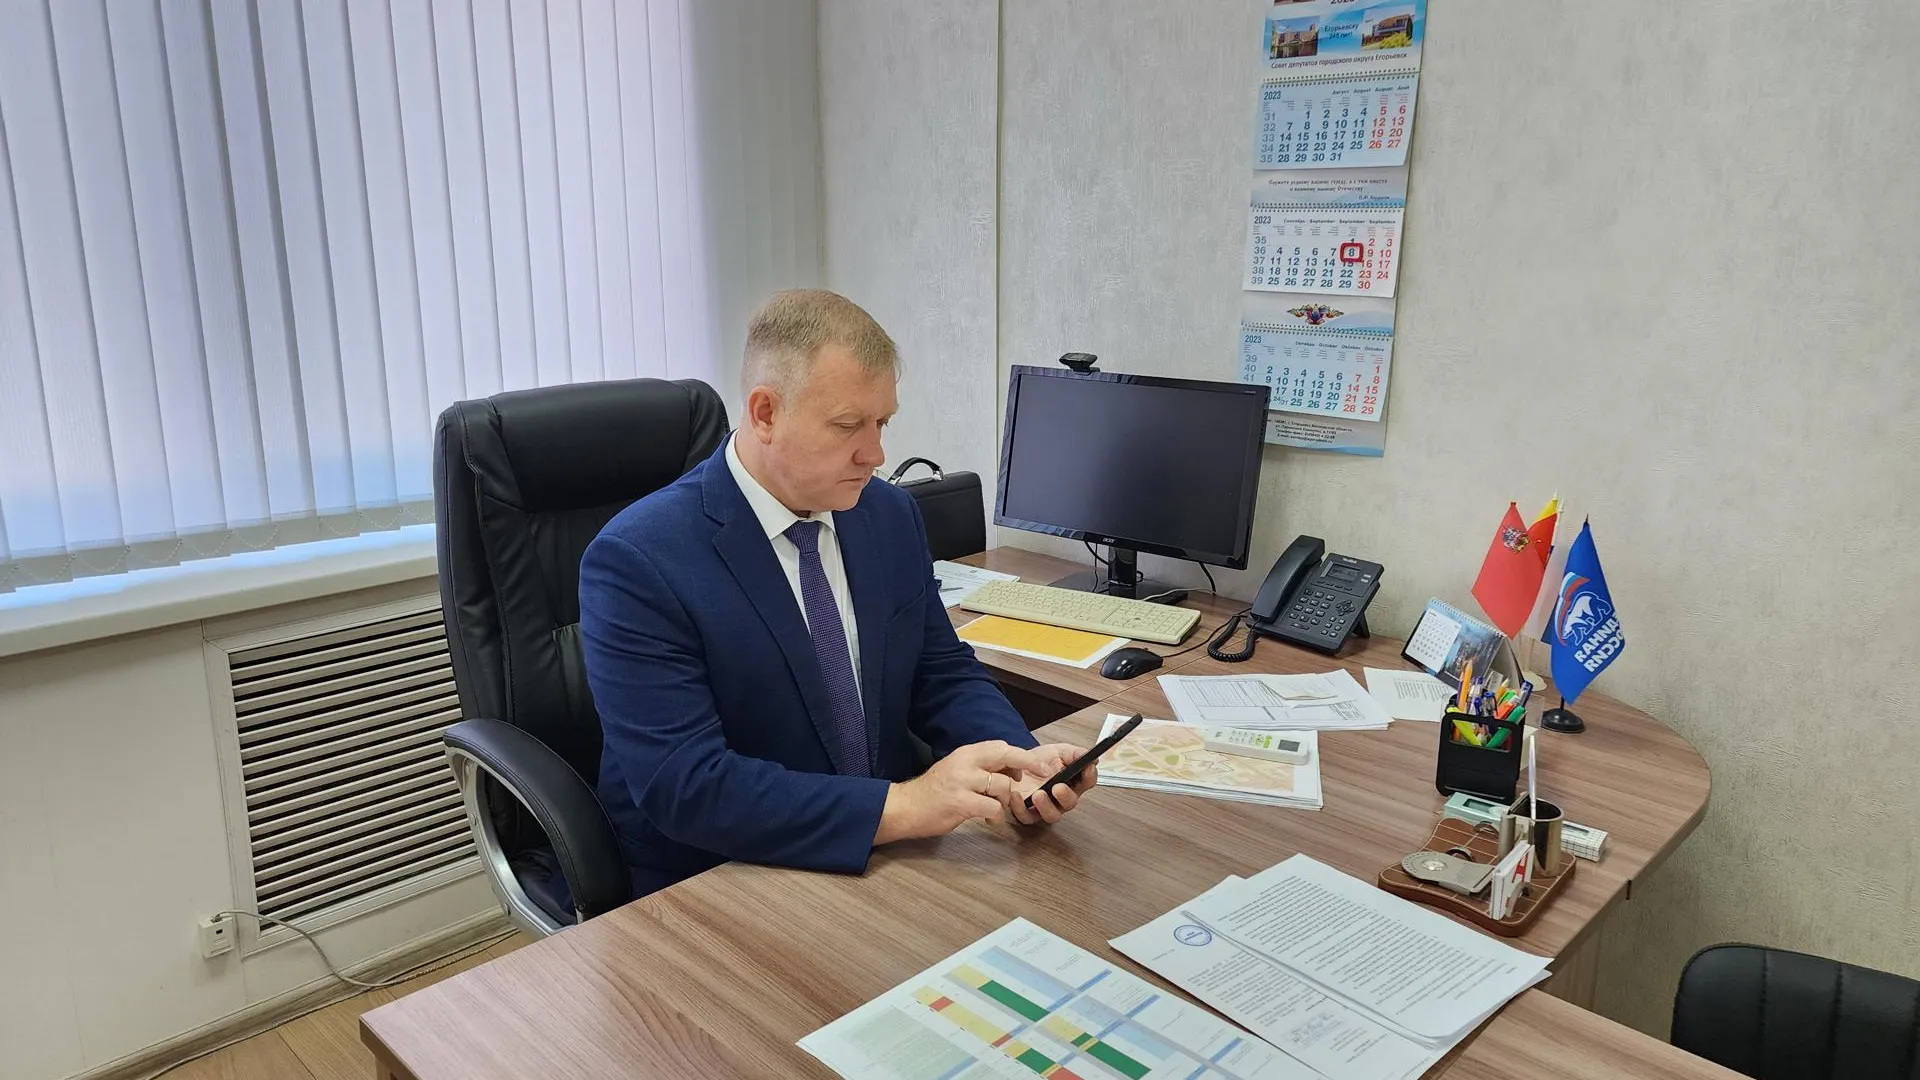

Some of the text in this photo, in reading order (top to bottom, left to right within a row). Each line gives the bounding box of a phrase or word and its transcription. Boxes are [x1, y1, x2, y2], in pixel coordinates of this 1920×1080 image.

[1325, 23, 1359, 32] Егорьевску
[1289, 59, 1318, 68] депутатов
[1319, 57, 1352, 65] городского
[1375, 52, 1407, 61] Егорьевск
[1264, 90, 1281, 100] 2023
[1264, 112, 1275, 121] 31
[1306, 110, 1310, 119] 1
[1324, 110, 1330, 118] 2
[1342, 108, 1348, 117] 3
[1360, 108, 1367, 116] 4
[1380, 106, 1386, 115] 5
[1400, 105, 1406, 114] 6
[1264, 116, 1404, 132] 32 7 8 9 10 11 12 13
[1262, 128, 1402, 142] 33 14 15 16 17 18 19 20
[1261, 139, 1401, 153] 34 21 22 23 24 25 26 27
[1260, 152, 1341, 162] 35 28 29 30 31
[1254, 216, 1271, 224] 2023
[1255, 236, 1266, 244] 35
[1368, 238, 1375, 246] 2
[1386, 238, 1392, 247] 3
[1254, 246, 1266, 254] 36
[1294, 247, 1300, 255] 5
[1331, 248, 1336, 256] 7
[1348, 248, 1355, 257] 8
[1368, 249, 1373, 257] 9
[1380, 250, 1391, 258] 10
[1253, 256, 1265, 265] 37
[1271, 256, 1280, 265] 11
[1306, 258, 1317, 266] 13
[1324, 258, 1335, 266] 14
[1360, 259, 1373, 268] 16
[1379, 260, 1390, 268] 17
[1252, 266, 1388, 279] 38 18 19 20 21 22 23 24
[1268, 277, 1279, 285] 25
[1320, 279, 1333, 287] 28
[1338, 280, 1351, 288] 29
[1358, 281, 1370, 289] 30
[1245, 335, 1261, 343] 2023
[1244, 364, 1256, 372] 40
[1356, 374, 1362, 382] 7
[1373, 376, 1380, 384] 8
[1277, 377, 1288, 385] 10
[1294, 379, 1304, 387] 11
[1312, 380, 1324, 388] 12
[1329, 382, 1341, 390] 13
[1348, 384, 1359, 392] 14
[1366, 386, 1378, 394] 15
[1276, 387, 1287, 395] 17
[1293, 389, 1304, 397] 18
[1327, 392, 1339, 400] 20
[1345, 394, 1356, 402] 21
[1364, 396, 1376, 404] 22
[1290, 398, 1302, 406] 25
[1307, 400, 1320, 408] 26
[1325, 402, 1338, 410] 27
[1344, 404, 1356, 412] 28
[1361, 406, 1374, 414] 29
